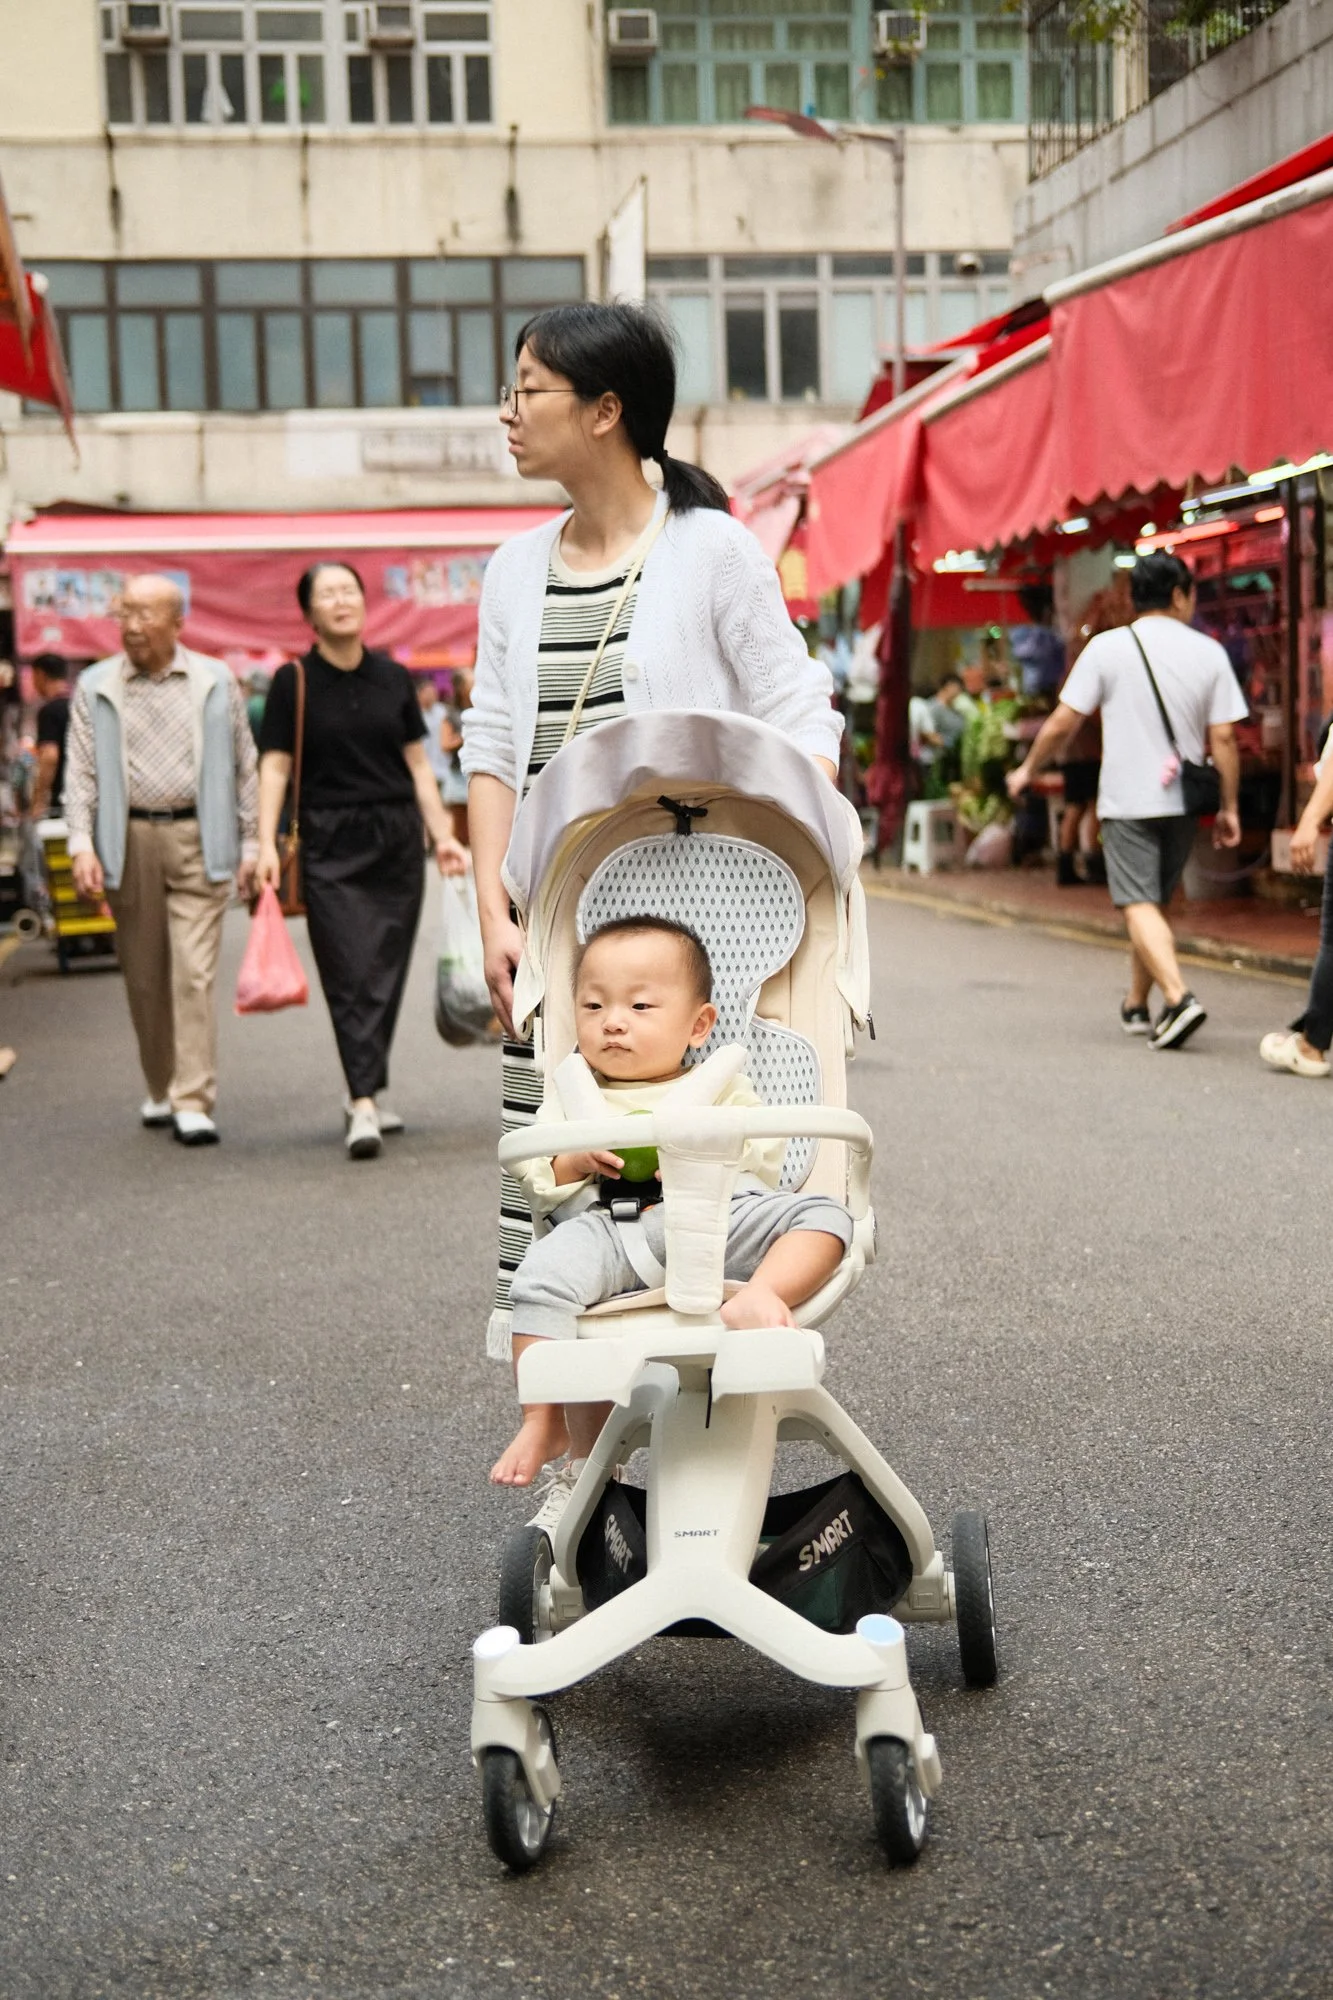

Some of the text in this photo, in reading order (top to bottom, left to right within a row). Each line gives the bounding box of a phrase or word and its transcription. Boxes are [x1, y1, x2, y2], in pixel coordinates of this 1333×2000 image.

[604, 1513, 633, 1573] SMART
[674, 1529, 719, 1538] SMART
[798, 1509, 854, 1572] SMART
